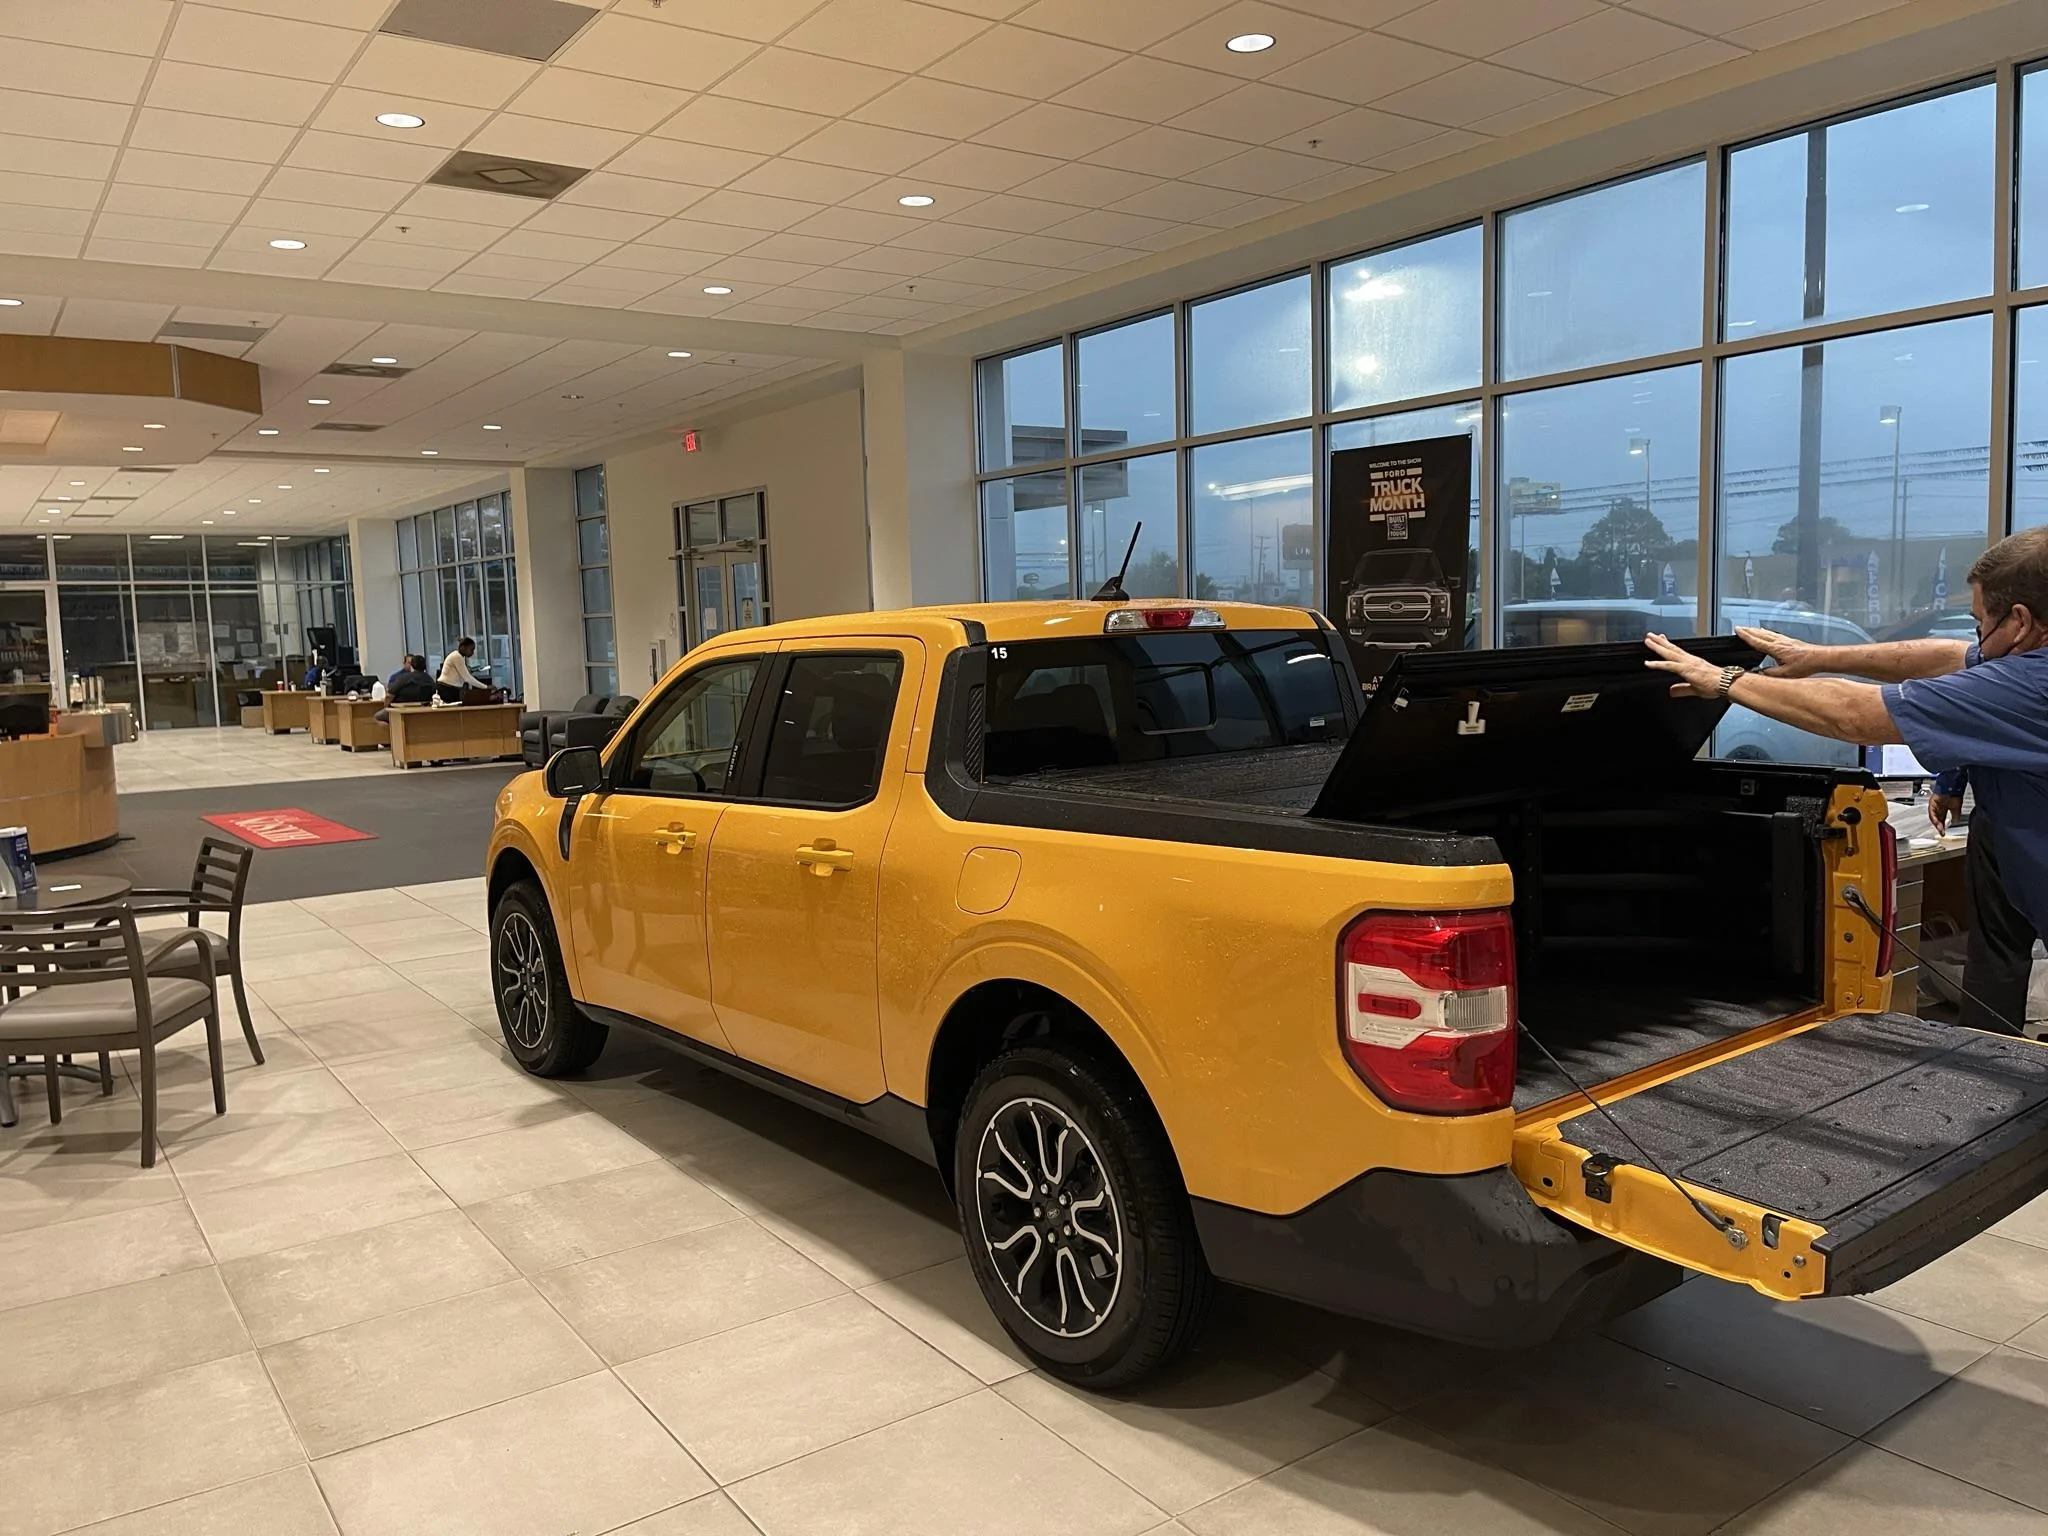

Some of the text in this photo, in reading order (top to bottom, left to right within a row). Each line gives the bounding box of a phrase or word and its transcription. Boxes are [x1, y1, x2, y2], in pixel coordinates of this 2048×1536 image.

[1384, 469, 1405, 478] FORD
[1371, 477, 1423, 497] TRUCK
[1370, 493, 1425, 512] MONTH
[1388, 515, 1405, 524] BUILT
[1295, 547, 1311, 556] LIN
[991, 647, 1008, 659] 15
